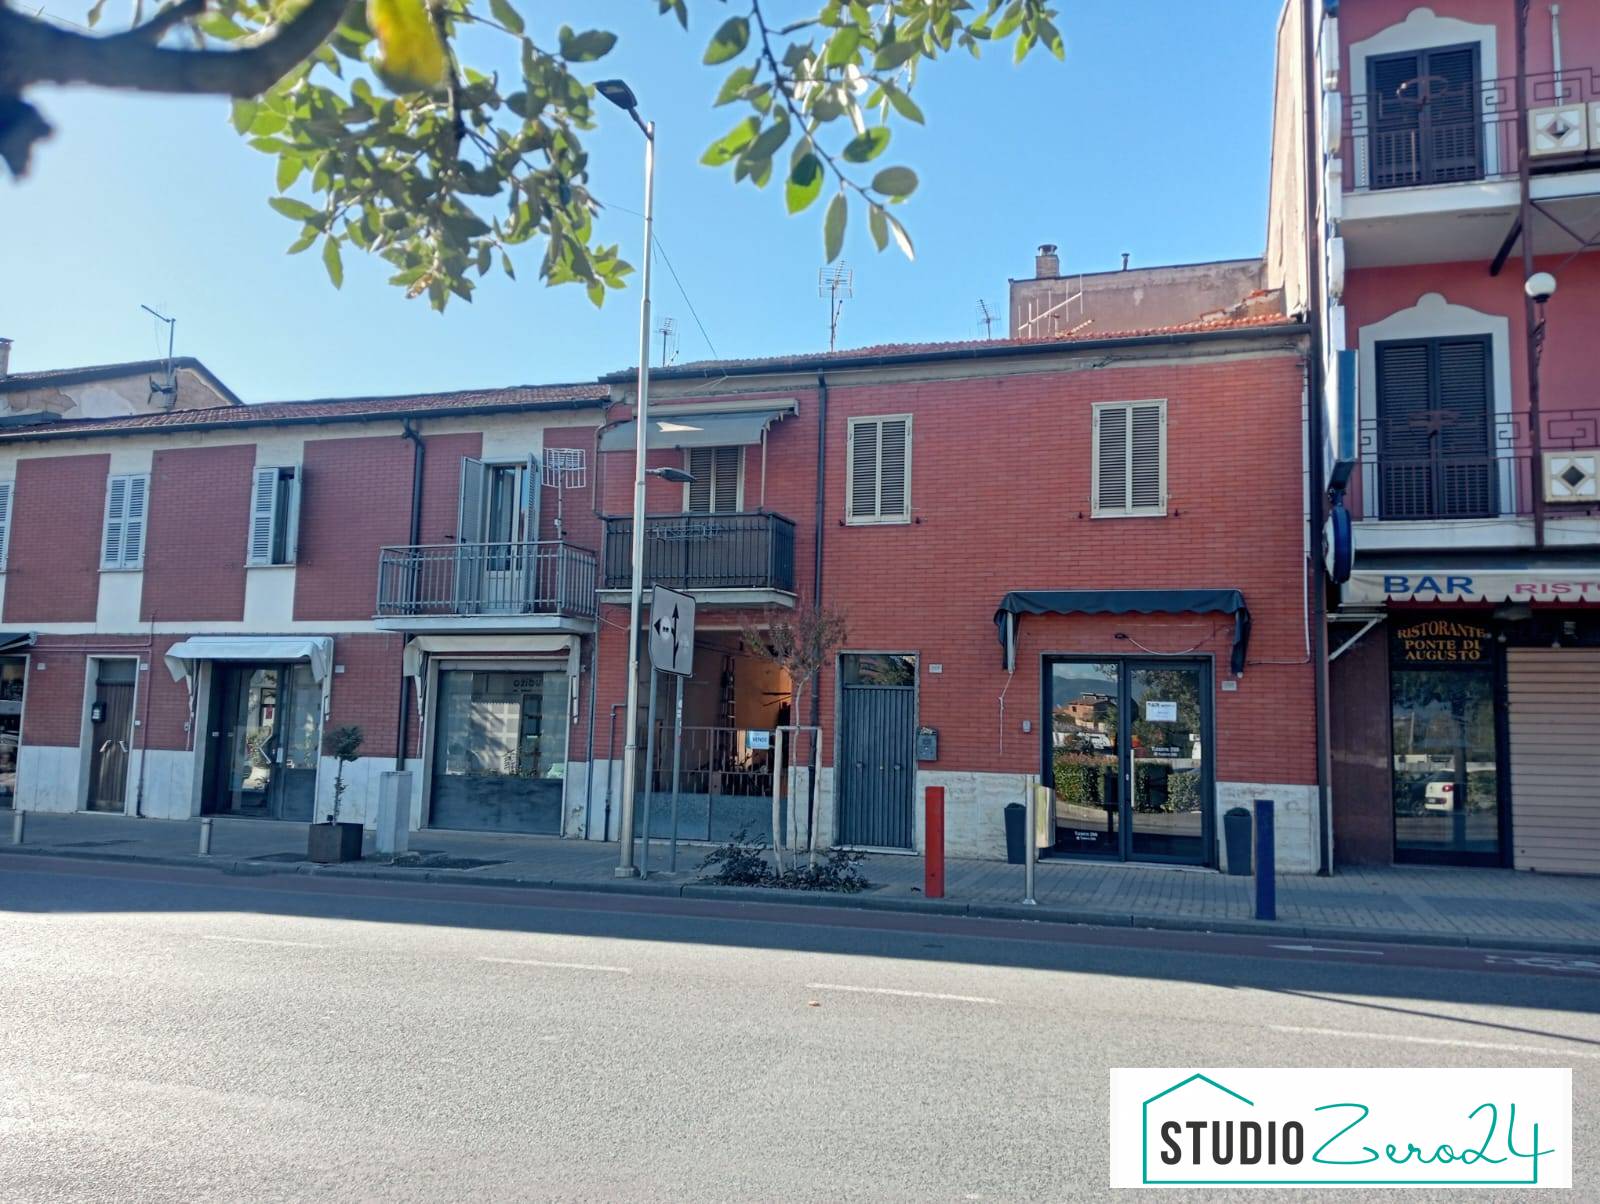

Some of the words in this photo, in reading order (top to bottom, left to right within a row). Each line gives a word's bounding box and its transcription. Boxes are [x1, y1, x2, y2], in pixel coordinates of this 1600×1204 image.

[1383, 575, 1474, 594] BAR
[1515, 581, 1600, 594] RIST
[1396, 620, 1486, 639] RISTORANTE
[1404, 639, 1457, 650] PONTE
[1463, 639, 1481, 650] DI
[1405, 650, 1481, 661] AUGUSTO
